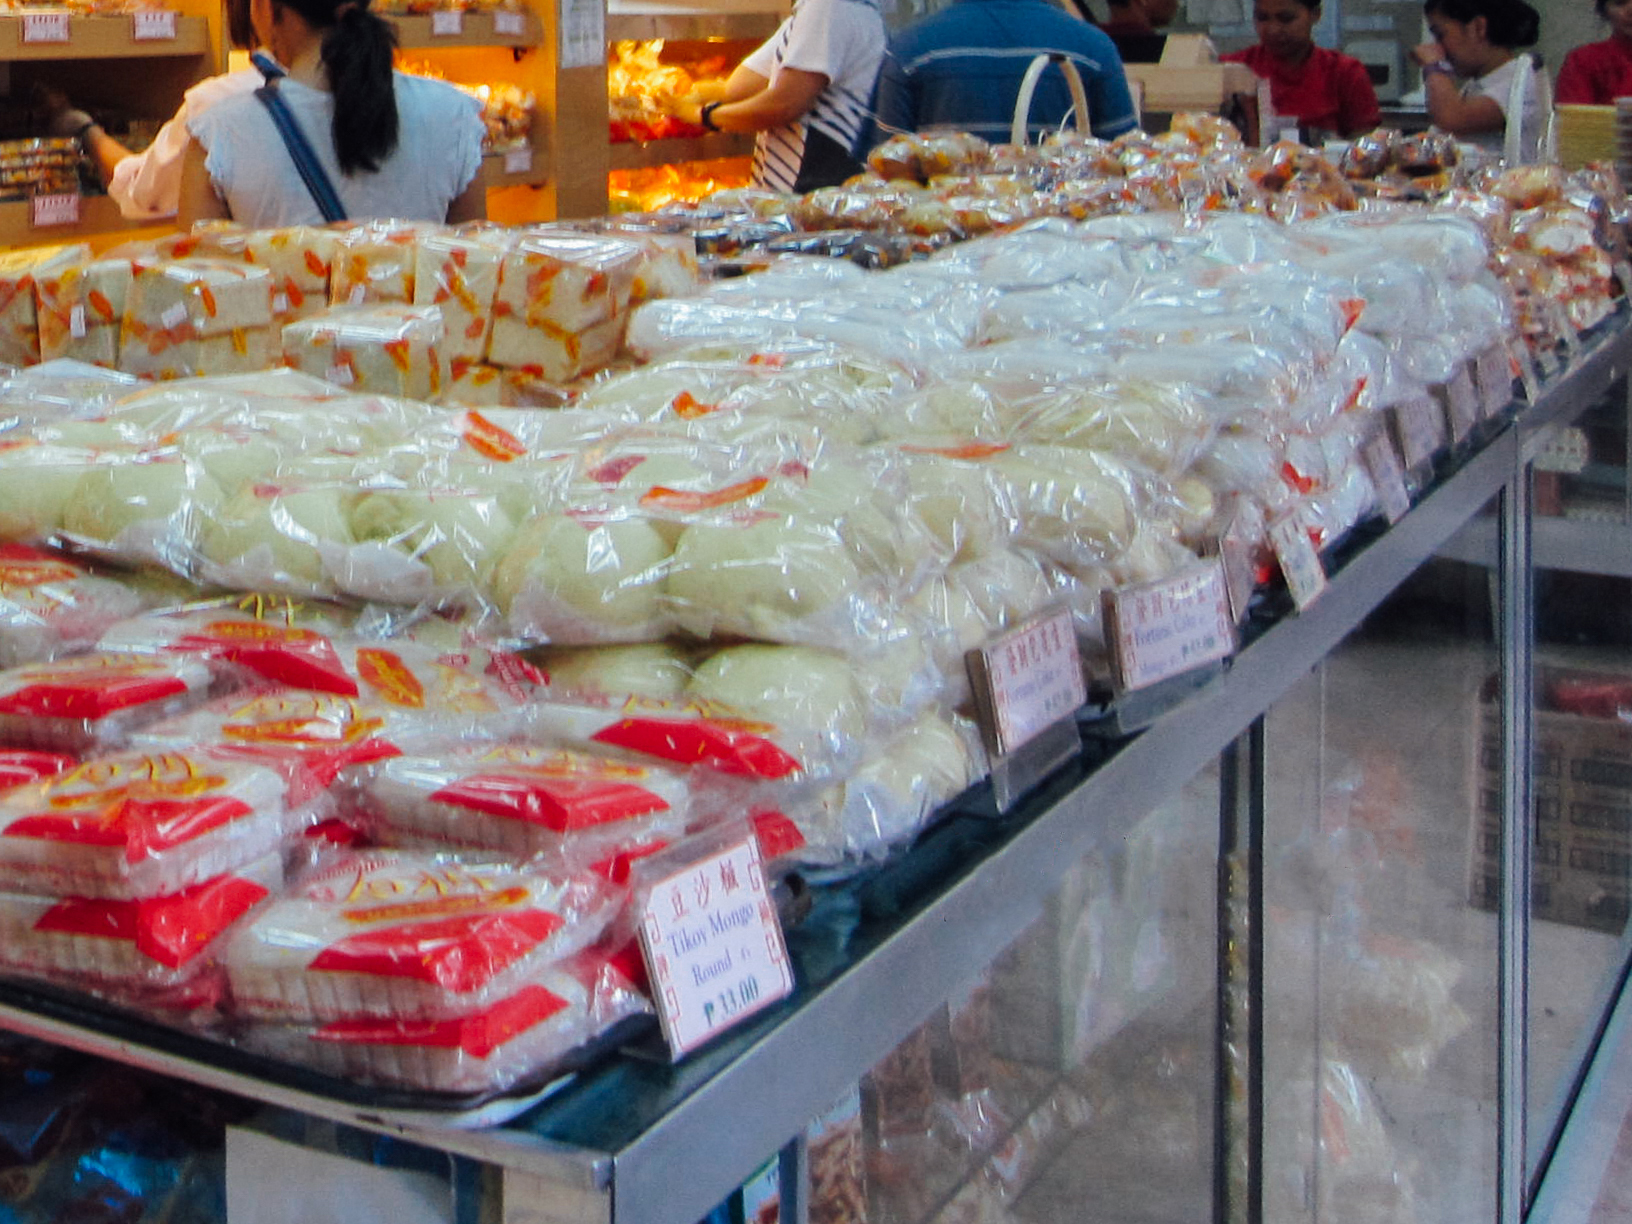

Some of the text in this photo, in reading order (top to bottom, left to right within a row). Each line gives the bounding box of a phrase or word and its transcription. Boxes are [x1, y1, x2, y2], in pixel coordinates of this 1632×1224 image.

[668, 902, 755, 958] Tikoy Mongo
[691, 948, 733, 987] Round
